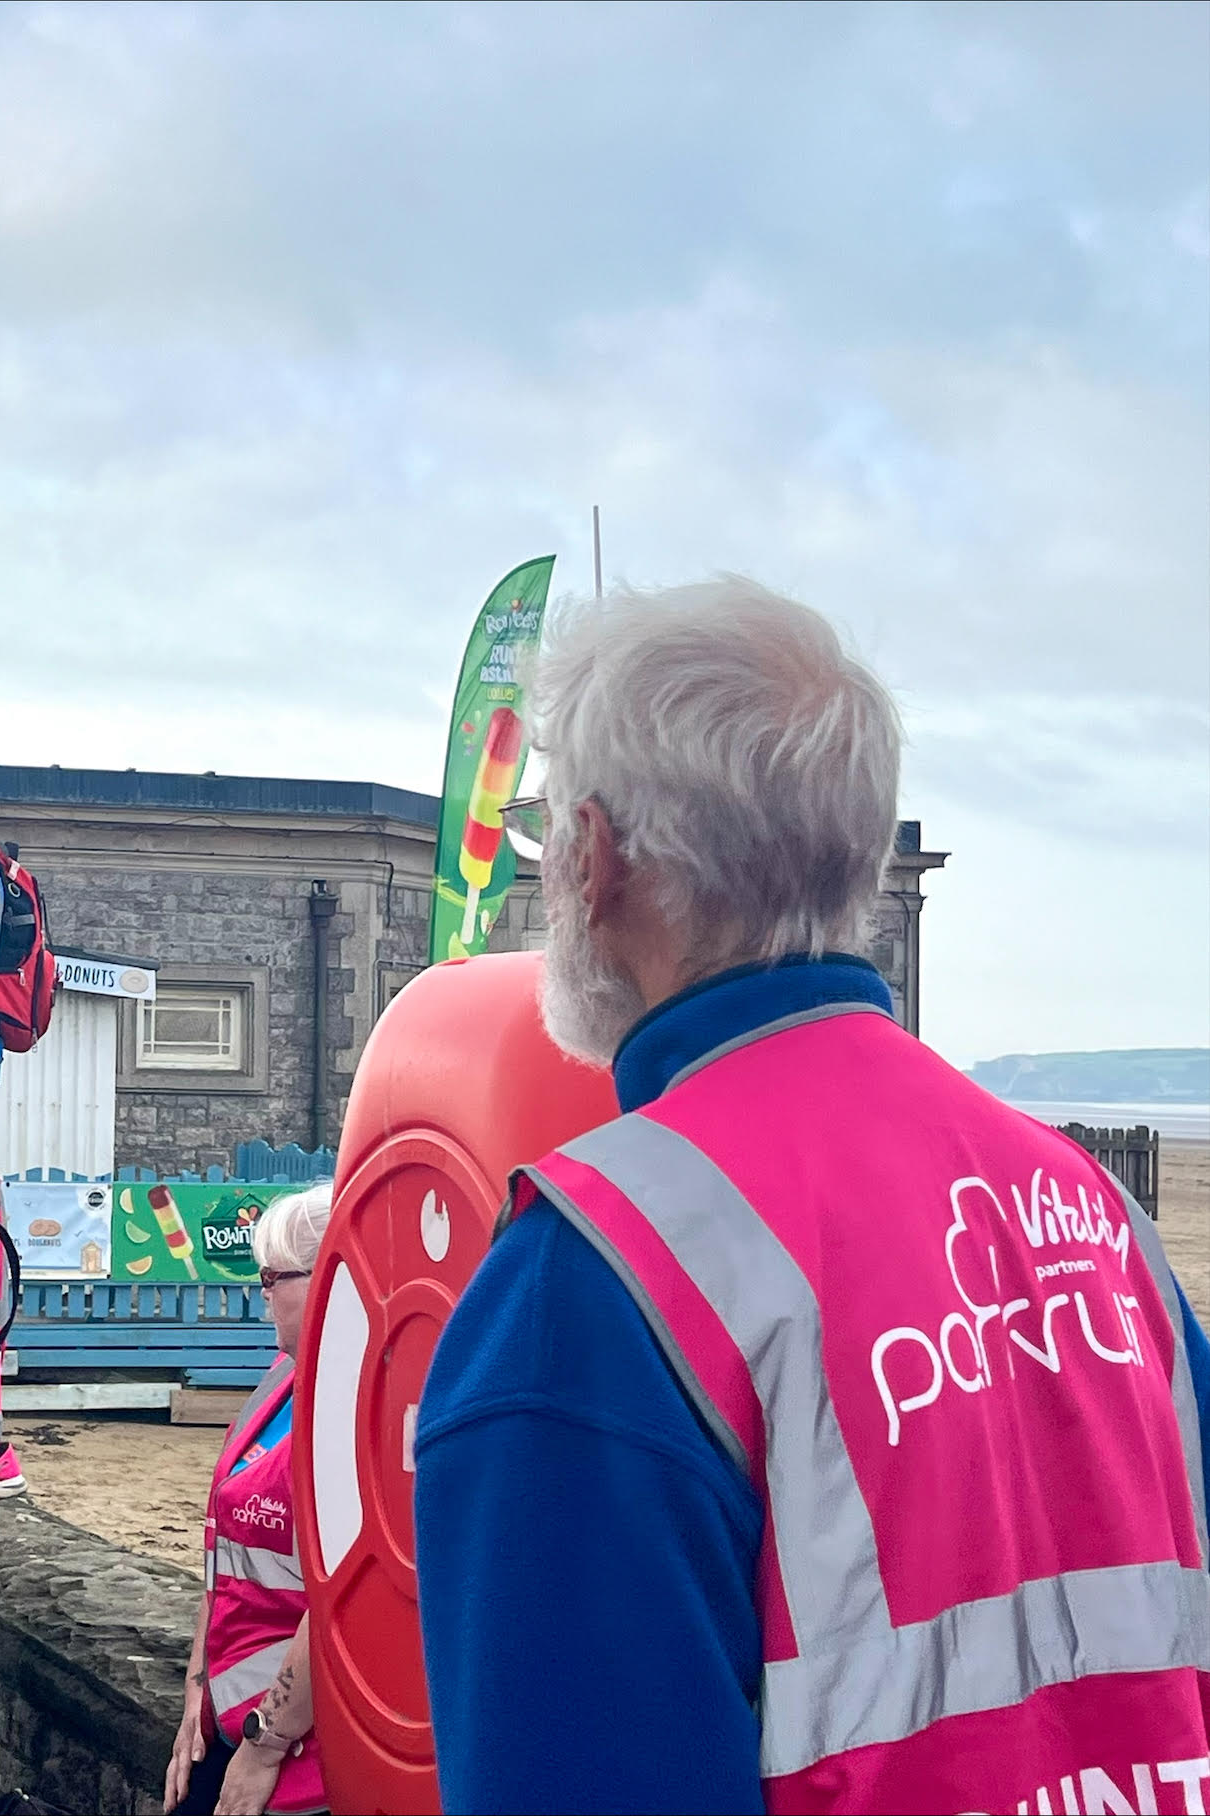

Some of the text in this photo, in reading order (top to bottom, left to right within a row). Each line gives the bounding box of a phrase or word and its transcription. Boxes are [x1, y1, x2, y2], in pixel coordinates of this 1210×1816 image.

[64, 964, 116, 988] DONUTS
[203, 1220, 256, 1250] Rownt
[1035, 1258, 1097, 1282] partners
